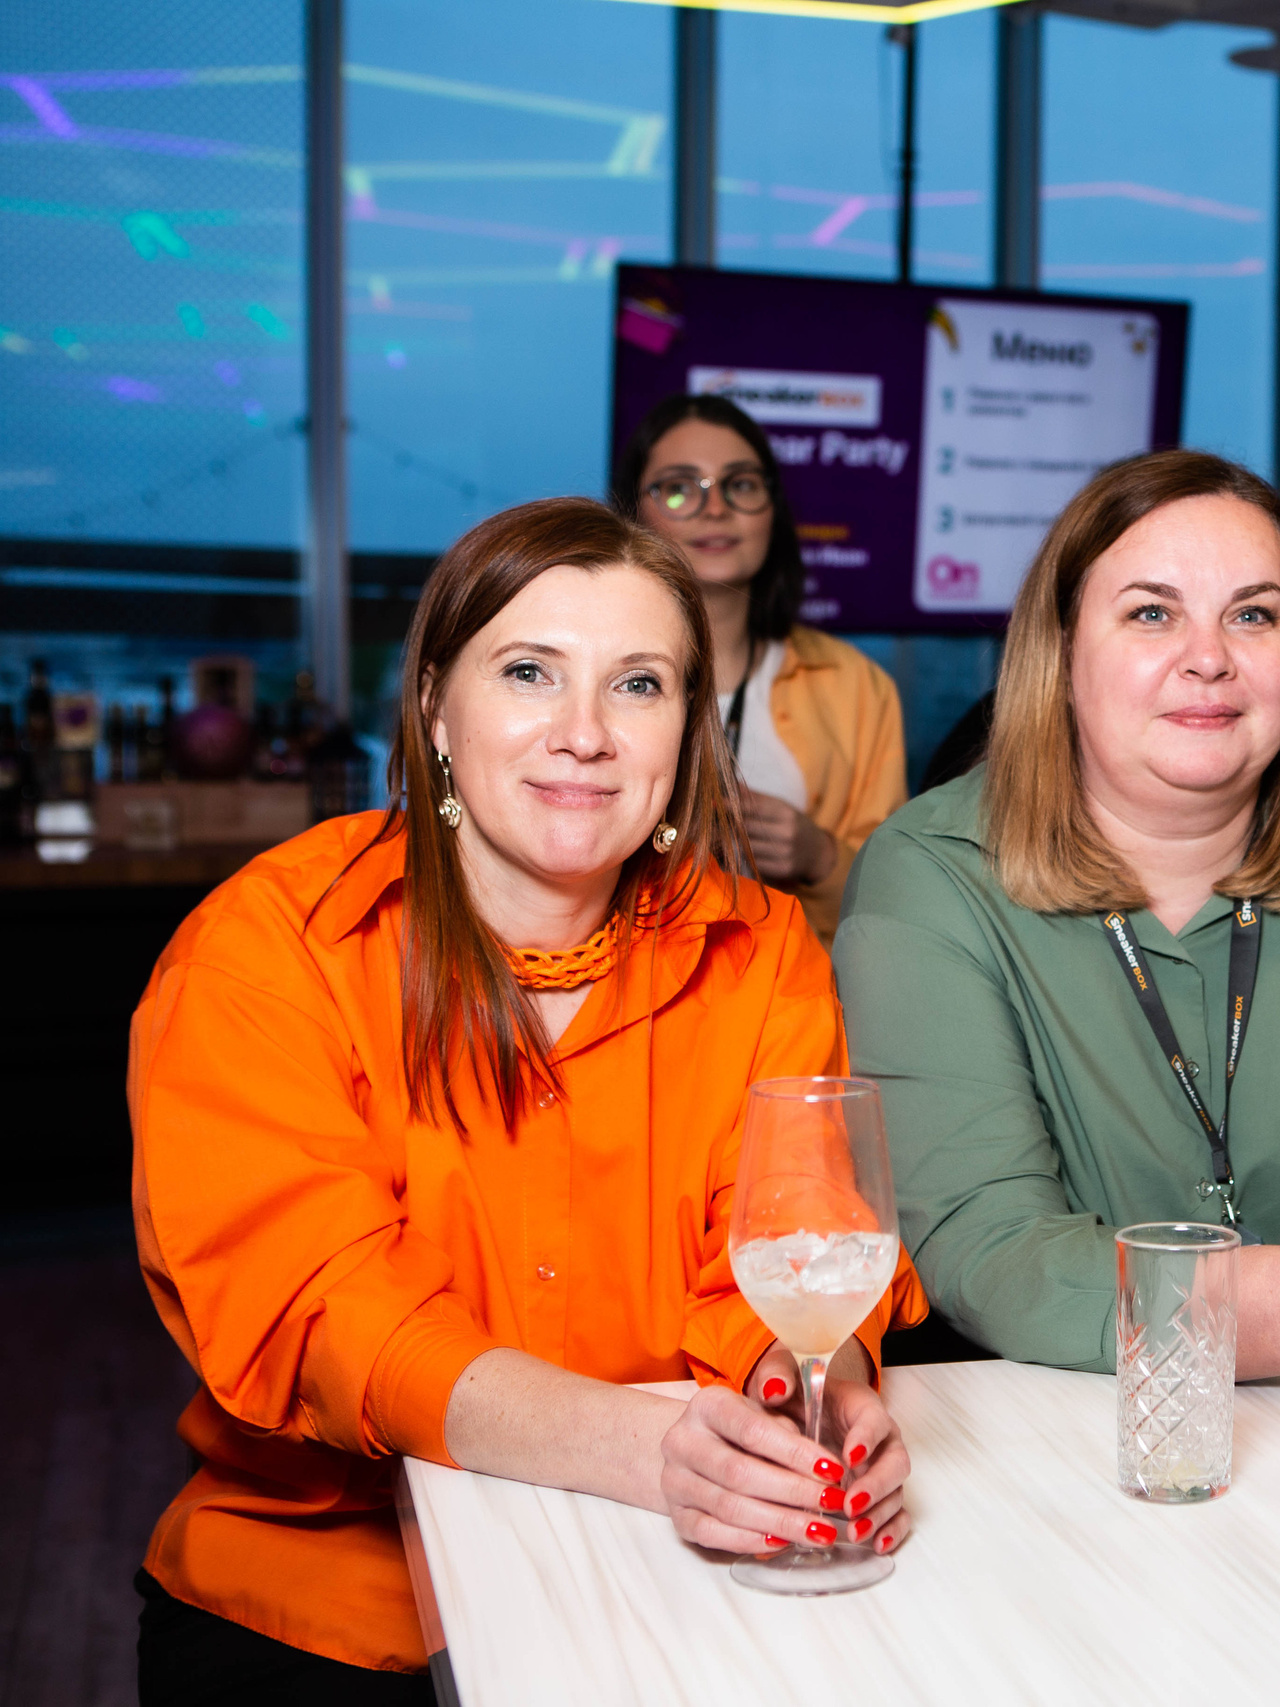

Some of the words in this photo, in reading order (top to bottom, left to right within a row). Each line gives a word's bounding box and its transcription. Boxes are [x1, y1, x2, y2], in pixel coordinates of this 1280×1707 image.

[991, 330, 1093, 368] Меню
[819, 430, 911, 476] Party
[1109, 916, 1149, 991] sneakerBOX
[1228, 995, 1244, 1073] sneakerBOX
